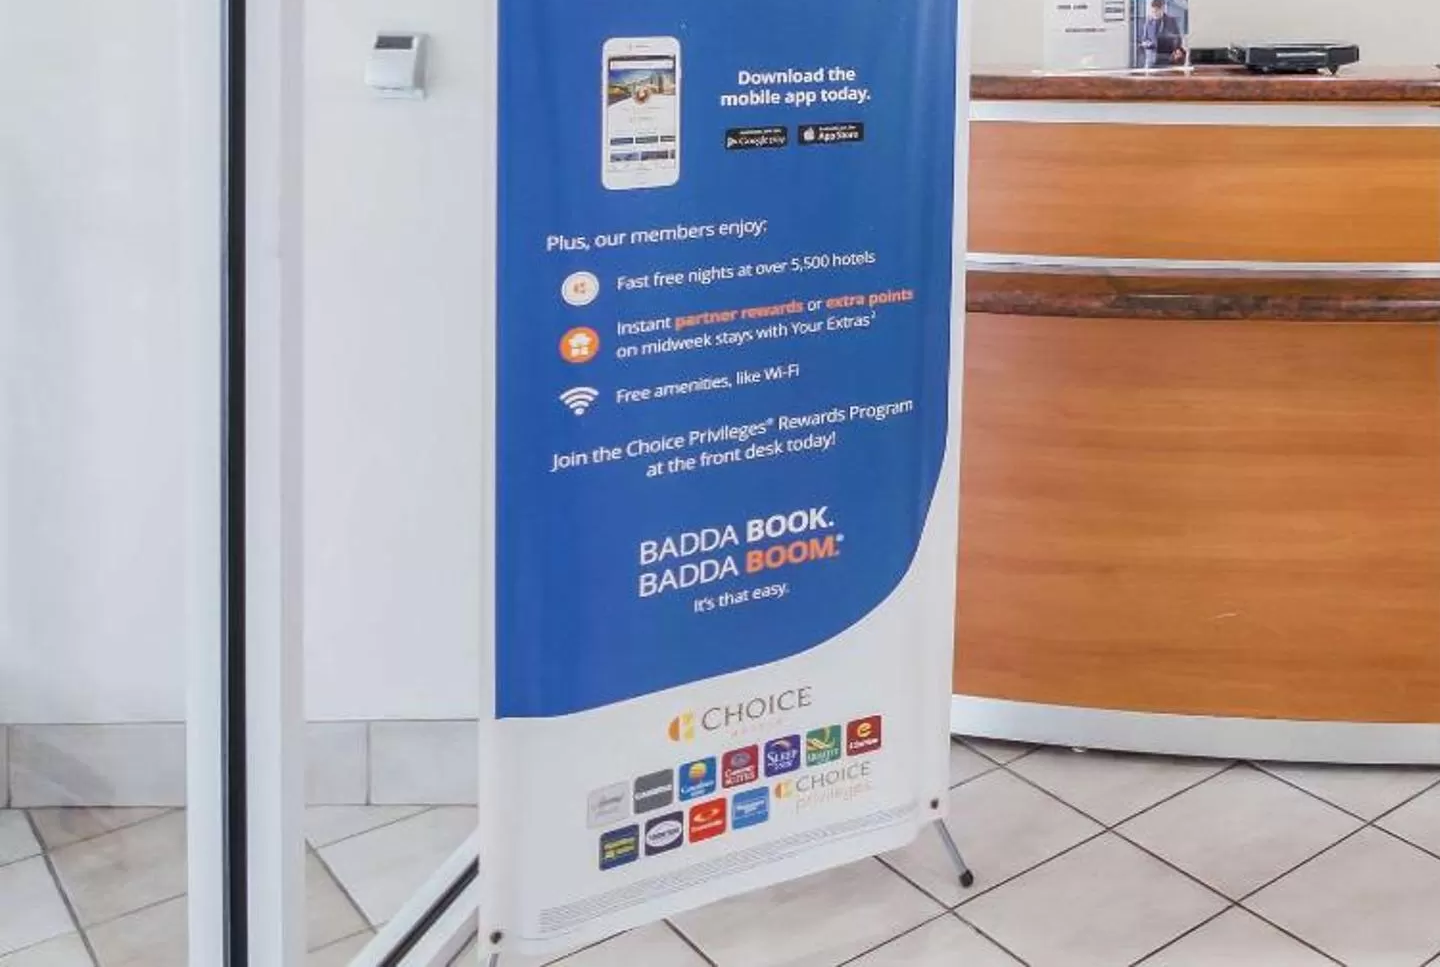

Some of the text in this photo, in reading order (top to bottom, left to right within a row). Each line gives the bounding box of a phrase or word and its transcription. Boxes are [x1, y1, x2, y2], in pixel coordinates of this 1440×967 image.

[738, 67, 856, 85] Download the
[720, 86, 871, 108] mobile app today.
[546, 219, 768, 252] Plus, our members enjoy:
[617, 250, 877, 291] Fast free nights at over 5,500 hotels
[616, 287, 914, 335] Instant partner rewards or extra points
[616, 345, 638, 359] on
[641, 333, 716, 355] midweek
[715, 328, 754, 346] stays
[755, 322, 788, 340] with
[791, 319, 824, 335] Your
[615, 363, 800, 404] Free amenities, like Wi-Fi
[549, 452, 588, 473] Join
[592, 445, 623, 463] the
[626, 435, 685, 458] Choice
[778, 409, 846, 431] Rewards
[849, 399, 913, 420] Program
[645, 430, 836, 478] at the front desk today!
[639, 505, 834, 566] BADDA BOOK.
[638, 555, 739, 598] BADDA
[693, 582, 790, 613] It's that easy.
[701, 685, 812, 731] CHOICE
[795, 761, 872, 793] CHOICE
